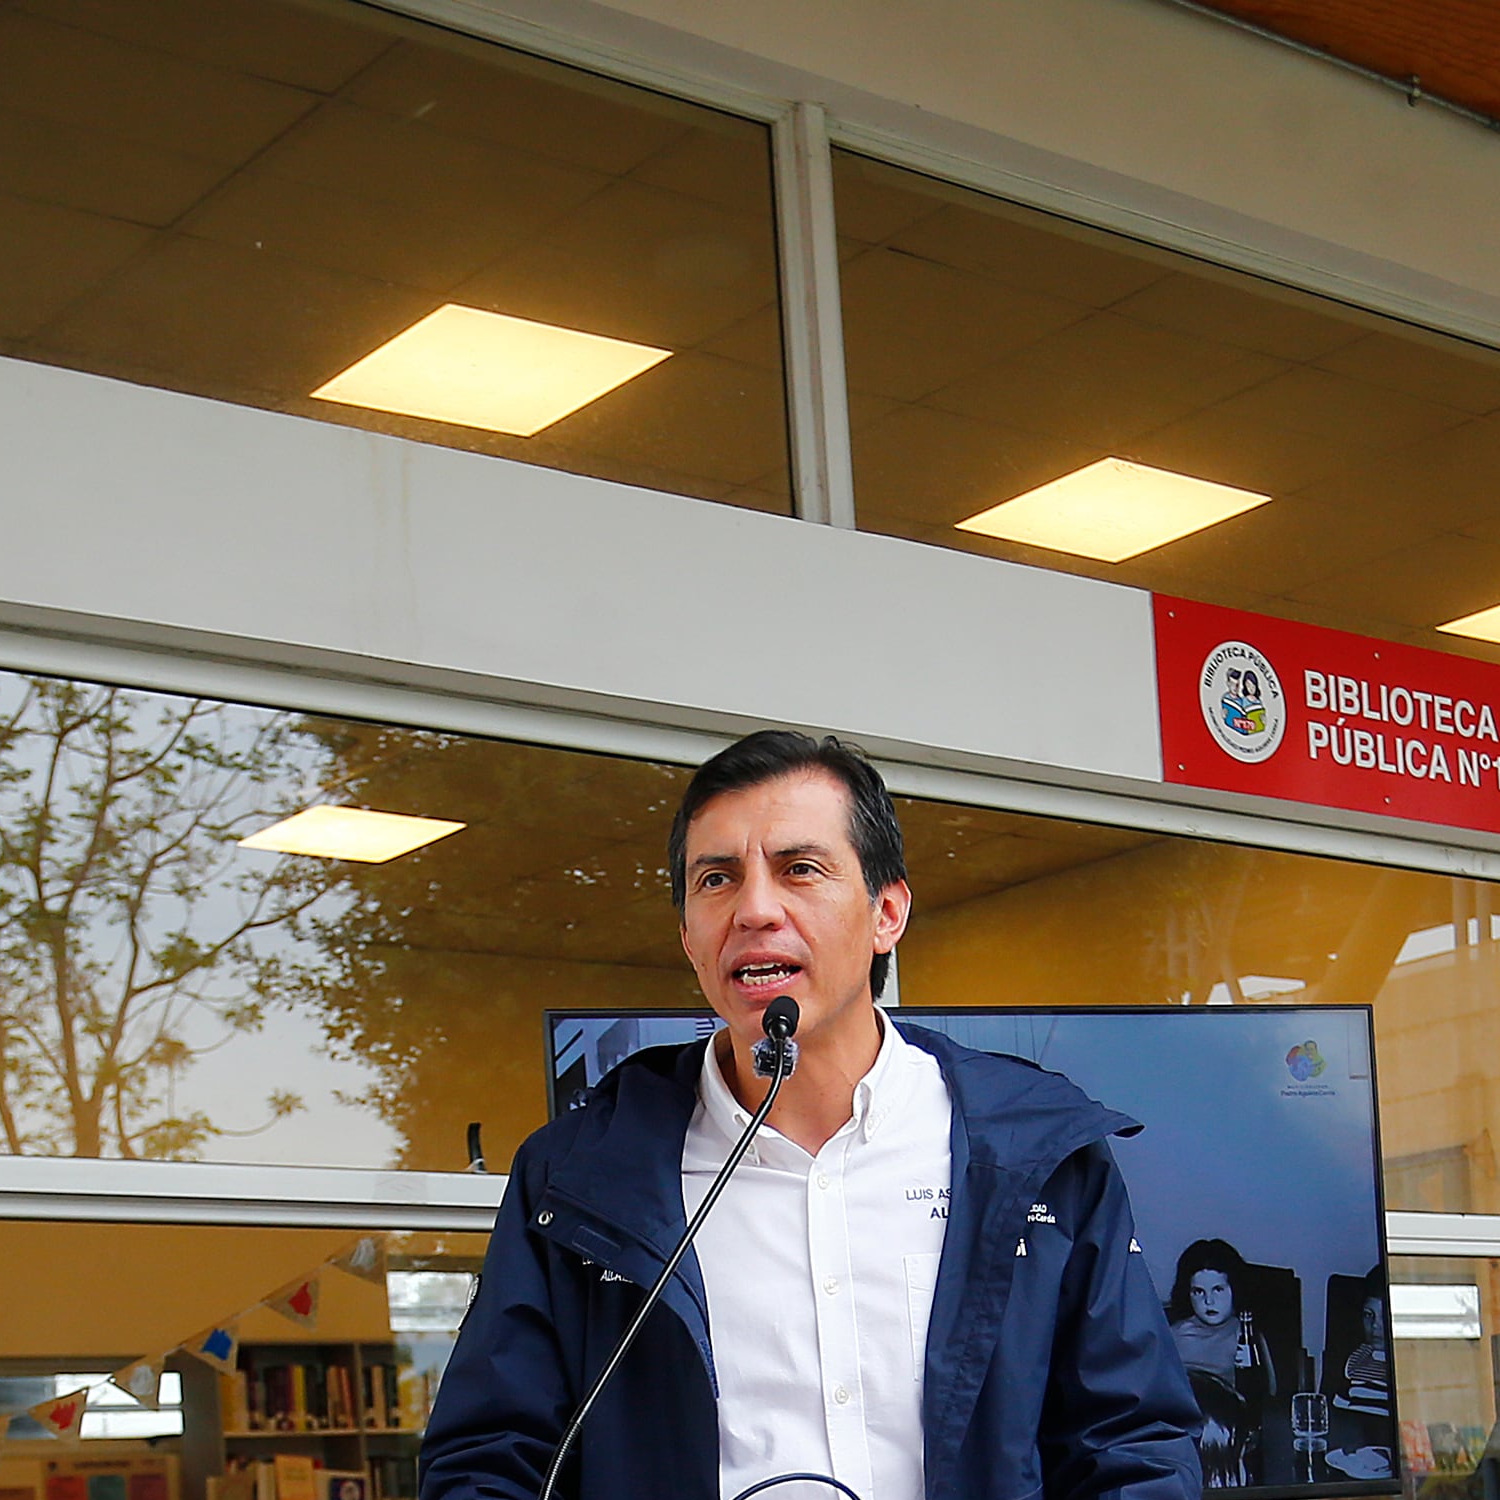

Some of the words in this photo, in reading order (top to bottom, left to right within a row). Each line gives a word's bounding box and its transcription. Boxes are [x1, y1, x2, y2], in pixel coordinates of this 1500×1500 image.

[1204, 647, 1247, 688] BIBLIOTECA
[1247, 650, 1280, 699] PÚBLICA
[1304, 669, 1499, 742] BIBLIOTECA
[1307, 717, 1452, 783] PÚBLICA
[905, 1188, 934, 1201] LUIS
